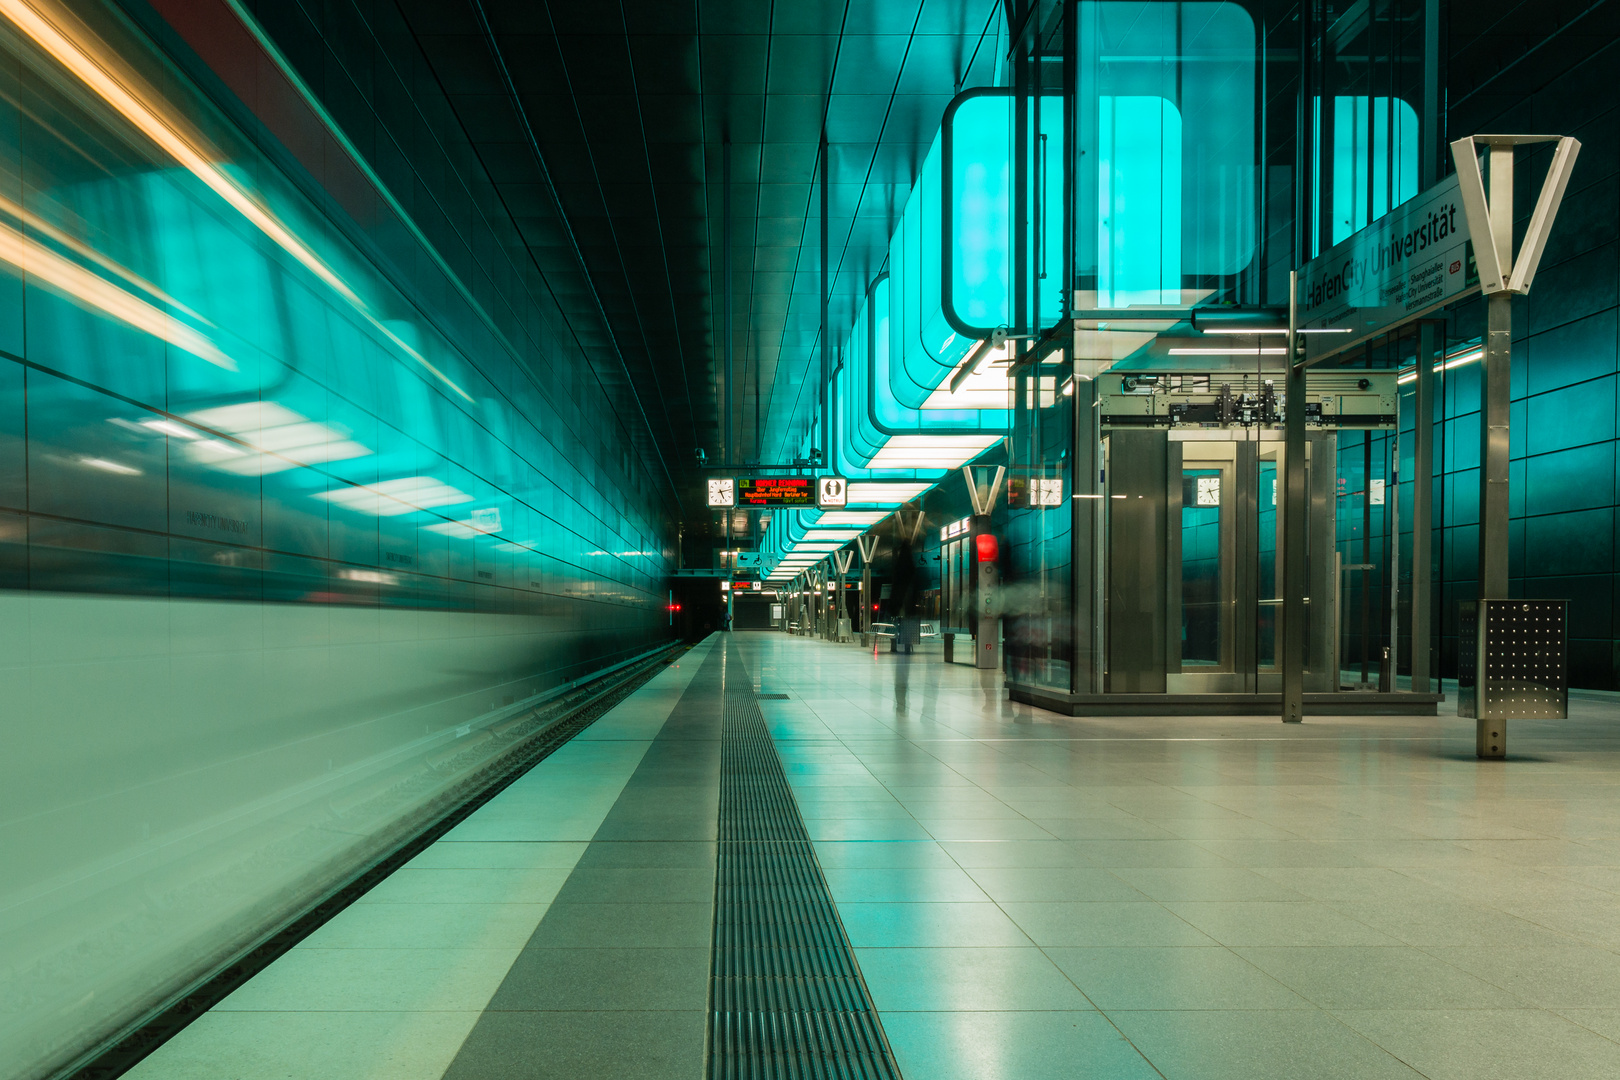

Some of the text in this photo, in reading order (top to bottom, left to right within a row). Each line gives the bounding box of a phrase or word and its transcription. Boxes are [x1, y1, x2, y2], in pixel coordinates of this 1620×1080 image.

[1306, 202, 1457, 312] HafenCity Universität
[1450, 262, 1460, 273] BUS
[1410, 261, 1443, 285] Shanghaiallee
[1417, 274, 1443, 293] Universität
